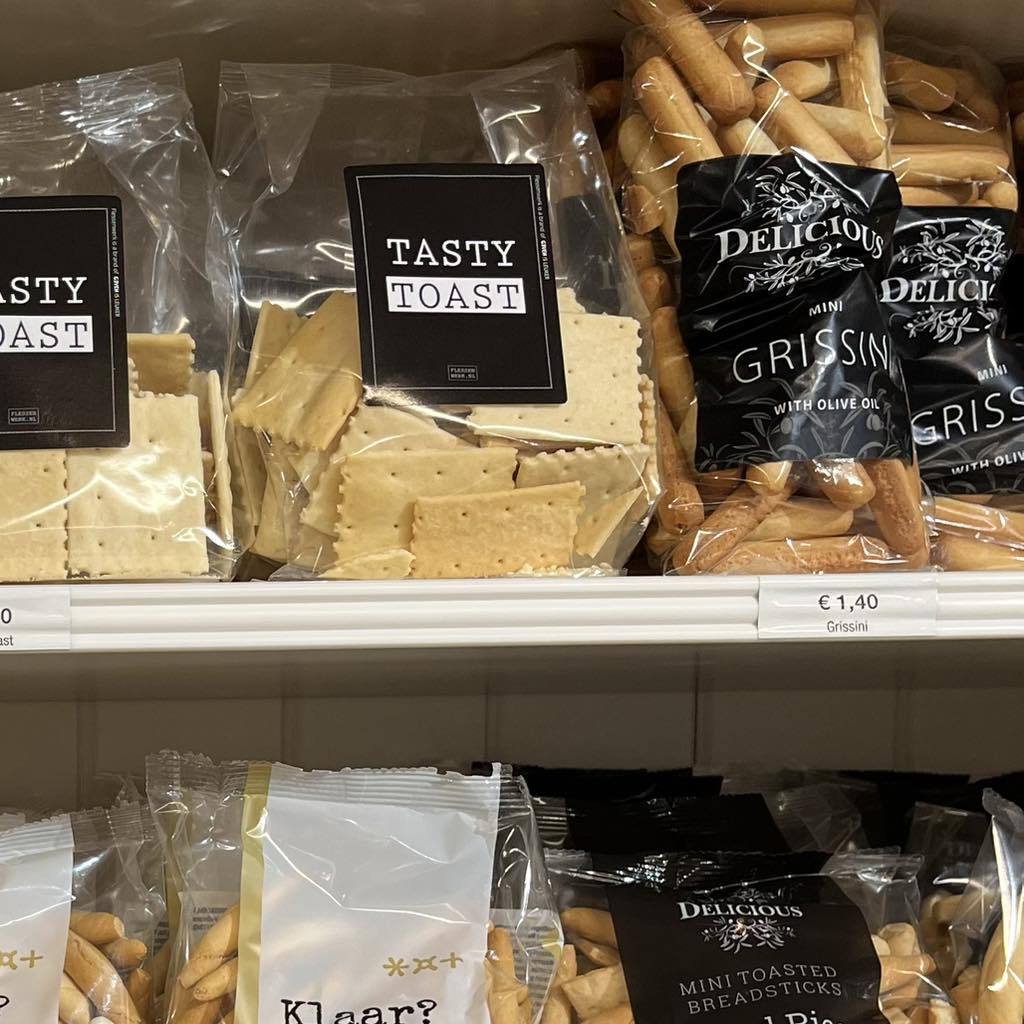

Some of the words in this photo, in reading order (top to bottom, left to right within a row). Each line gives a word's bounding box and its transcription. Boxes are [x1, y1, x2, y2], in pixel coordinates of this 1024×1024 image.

[714, 214, 884, 265] DELICIOUS
[387, 238, 516, 267] TASTY
[391, 282, 520, 310] TOAST
[808, 300, 843, 317] MINI
[976, 365, 1008, 383] MINI
[773, 400, 814, 416] WITH
[817, 397, 858, 412] OLIVE
[860, 396, 881, 410] OIL
[951, 459, 991, 475] WITH
[818, 594, 831, 610] €
[836, 593, 879, 613] 1,40
[827, 620, 868, 633] Grissini
[678, 901, 804, 921] DELICIOUS
[679, 975, 733, 998] MINI
[737, 963, 838, 986] TOASTED
[687, 980, 843, 1016] BREADSTICKS
